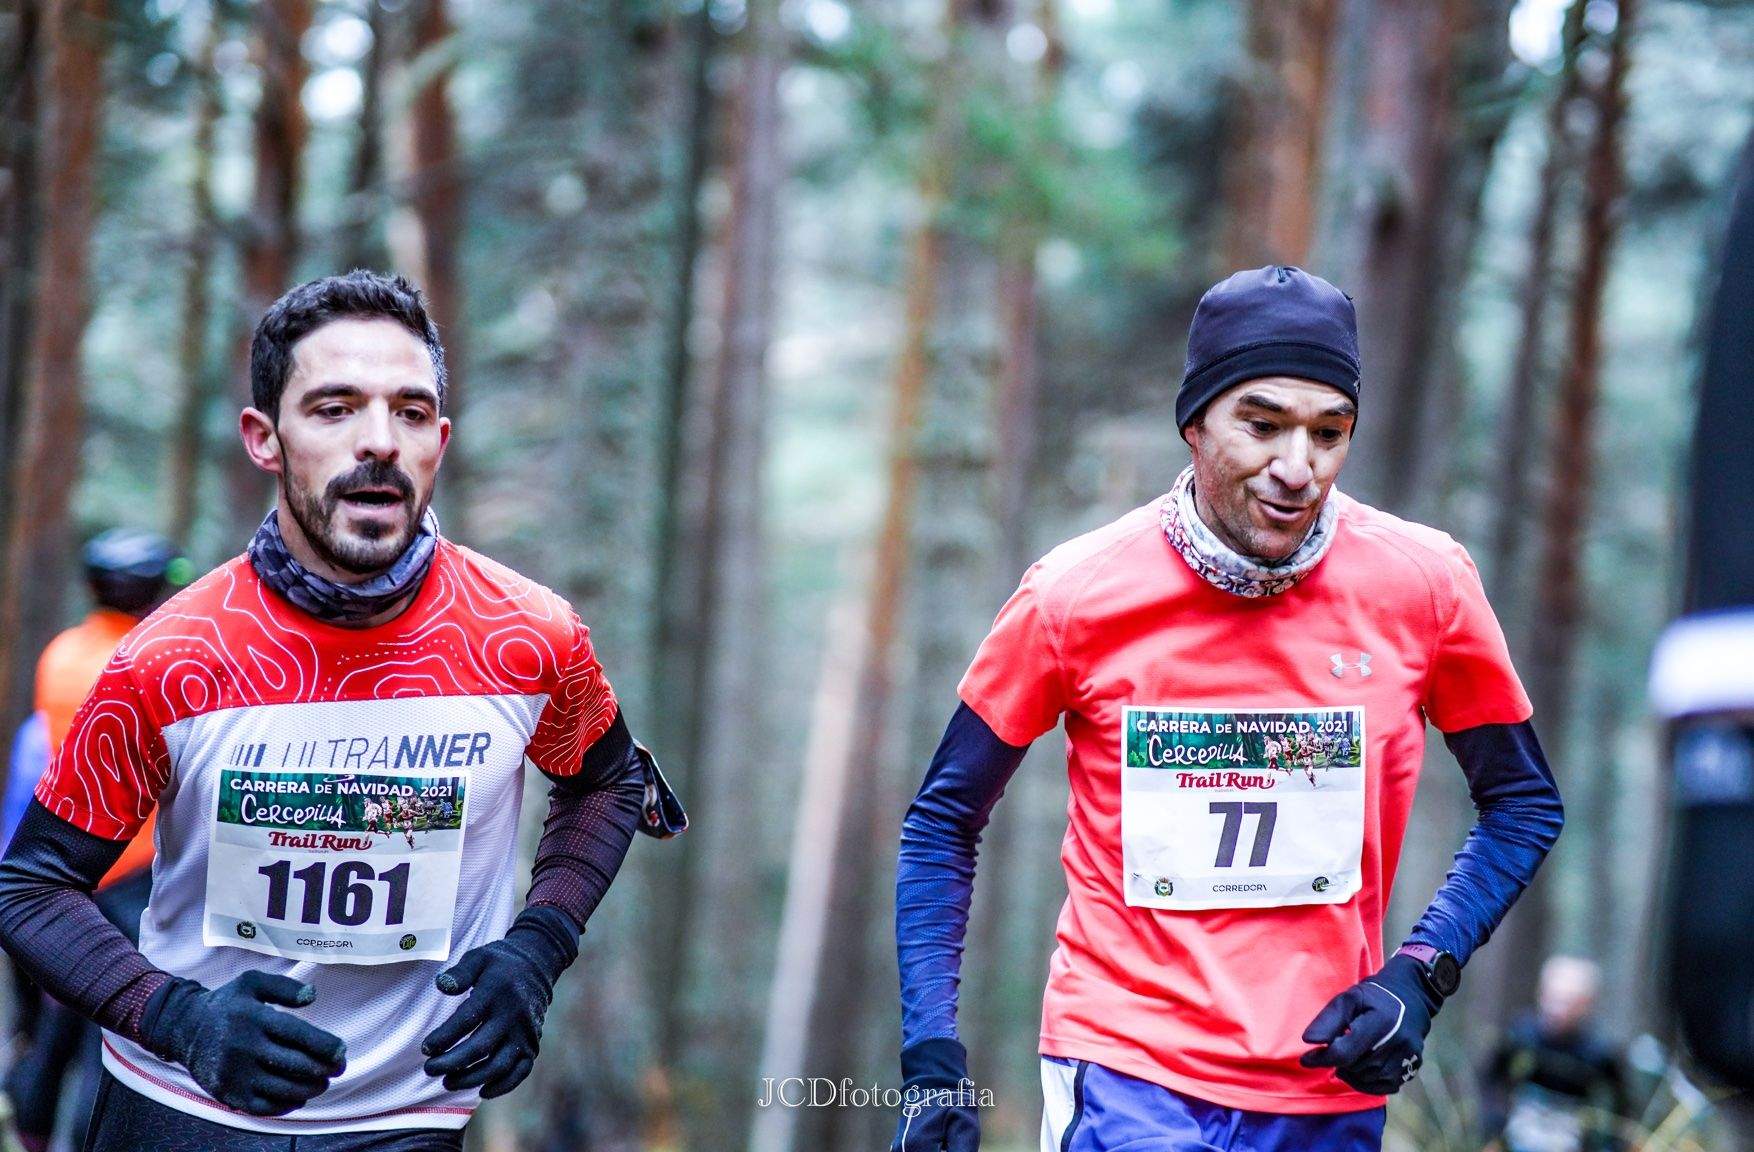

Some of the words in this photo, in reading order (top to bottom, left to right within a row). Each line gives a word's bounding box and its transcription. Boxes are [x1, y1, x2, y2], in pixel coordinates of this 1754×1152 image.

[1137, 719, 1211, 734] CARRERA
[1215, 724, 1232, 734] DE
[1236, 720, 1310, 734] NAVIDAD
[1316, 720, 1348, 733] 2021
[230, 778, 310, 795] CARRERA
[314, 784, 333, 794] DE
[336, 783, 414, 798] NAVIDAD
[421, 784, 453, 798] 2021
[1176, 772, 1223, 788] Trail
[1222, 772, 1275, 790] Run
[268, 831, 320, 849] Trail
[319, 833, 373, 851] Run
[1209, 802, 1278, 868] 77
[258, 859, 411, 926] 1161
